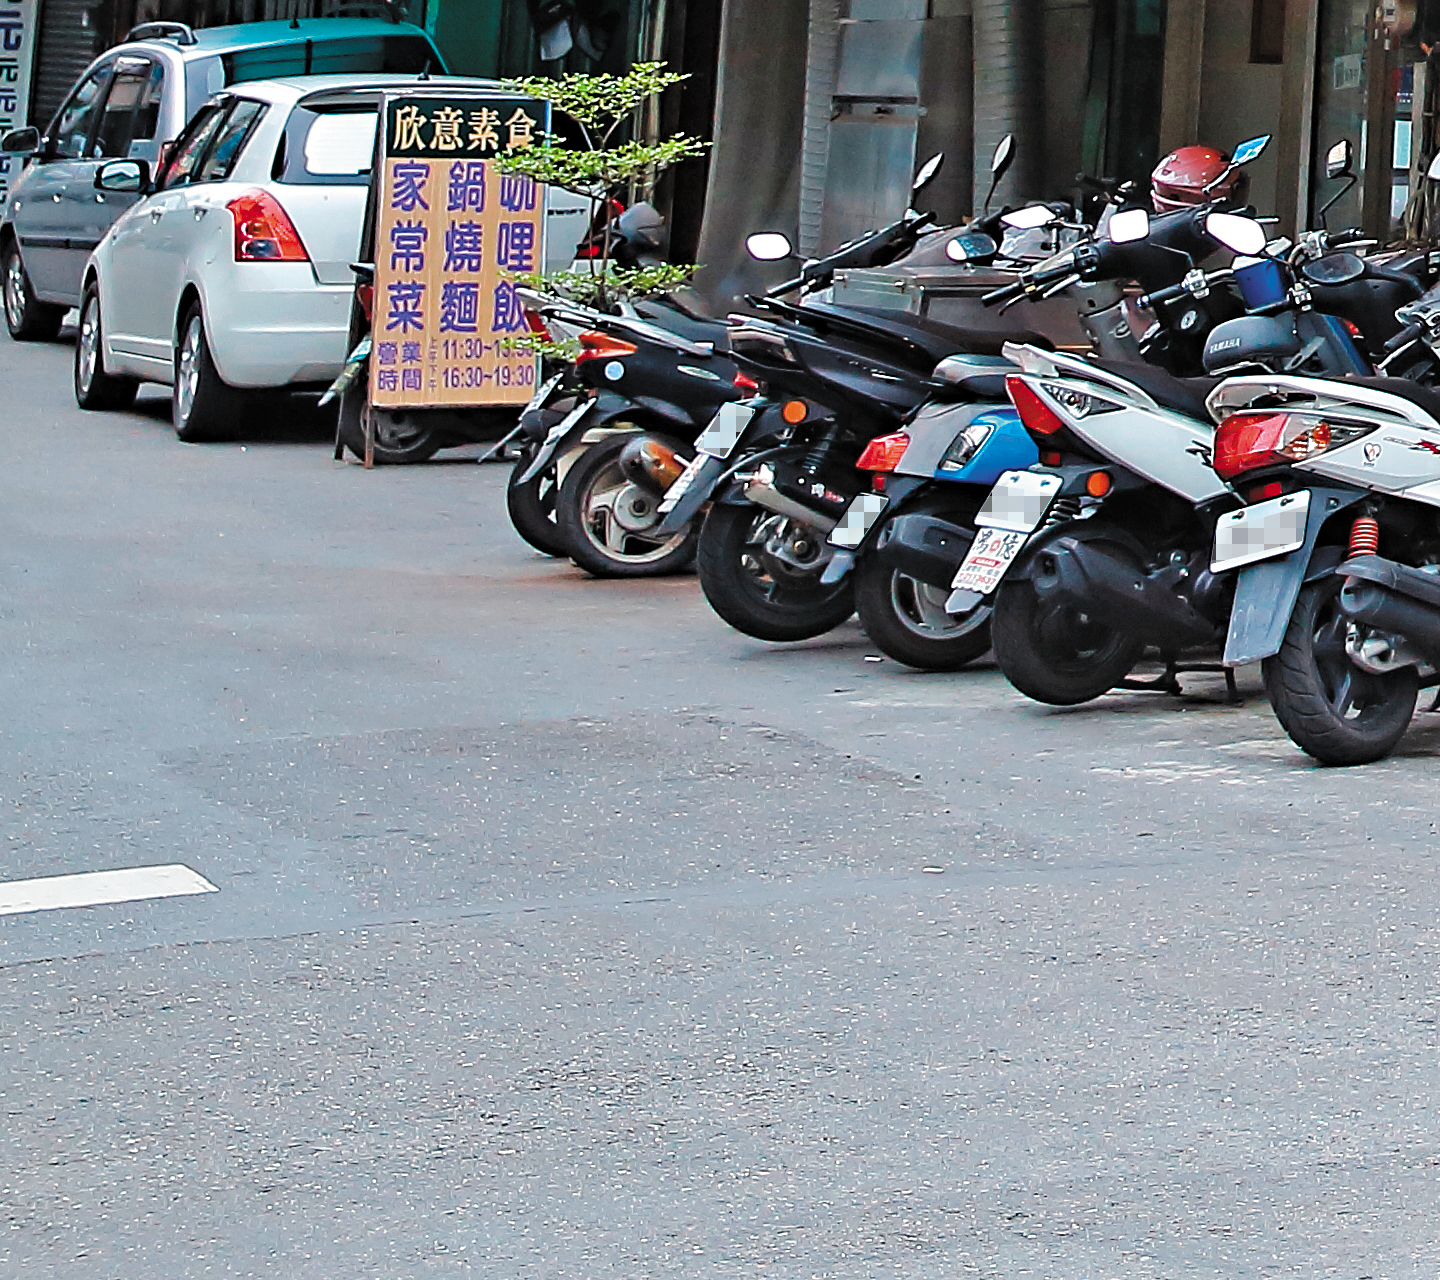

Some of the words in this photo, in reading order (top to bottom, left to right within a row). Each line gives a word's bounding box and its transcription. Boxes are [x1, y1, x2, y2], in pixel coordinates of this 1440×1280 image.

[392, 105, 537, 151] 欣意素食
[386, 159, 430, 334] 家常菜
[439, 161, 485, 334] 鍋燒麵
[491, 171, 537, 334] 咖哩飯
[379, 342, 421, 365] 營業
[378, 368, 421, 390] 時間
[443, 366, 534, 388] 16:30~19:30
